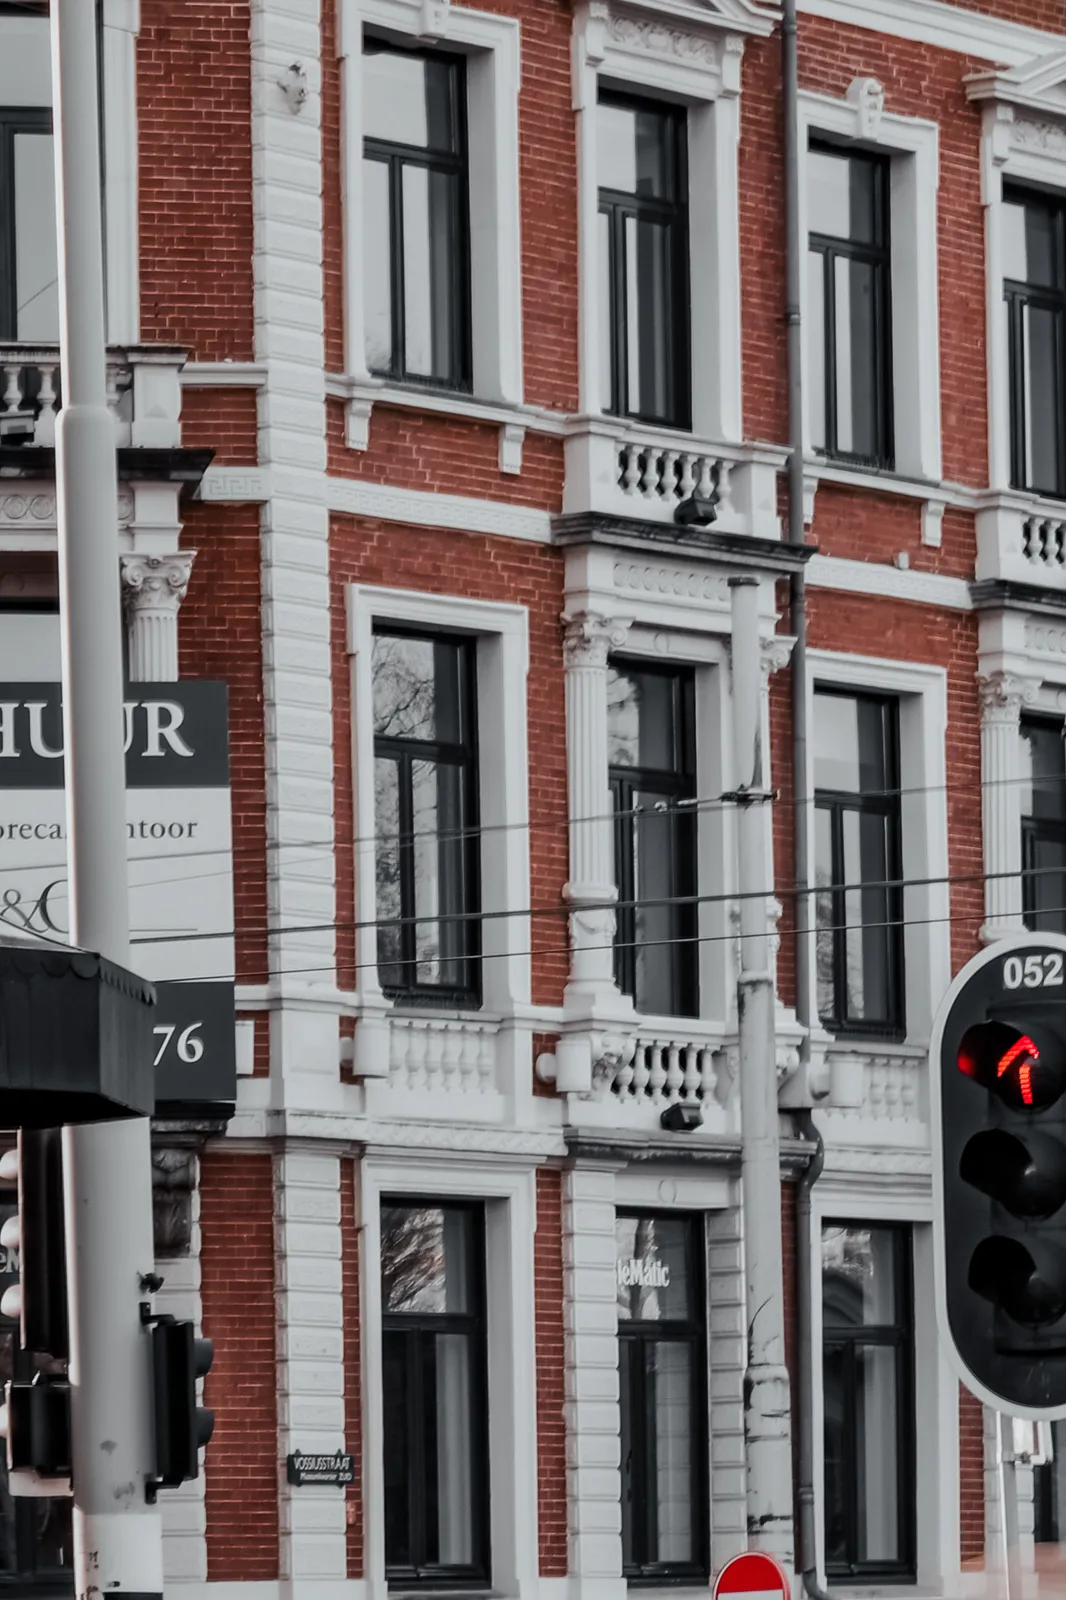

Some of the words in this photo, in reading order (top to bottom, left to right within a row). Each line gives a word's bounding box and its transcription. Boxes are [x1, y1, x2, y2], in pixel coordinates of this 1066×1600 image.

[1003, 953, 1064, 989] 052
[153, 1022, 203, 1066] 76
[293, 1456, 350, 1470] VOSSIUSSTRAAT
